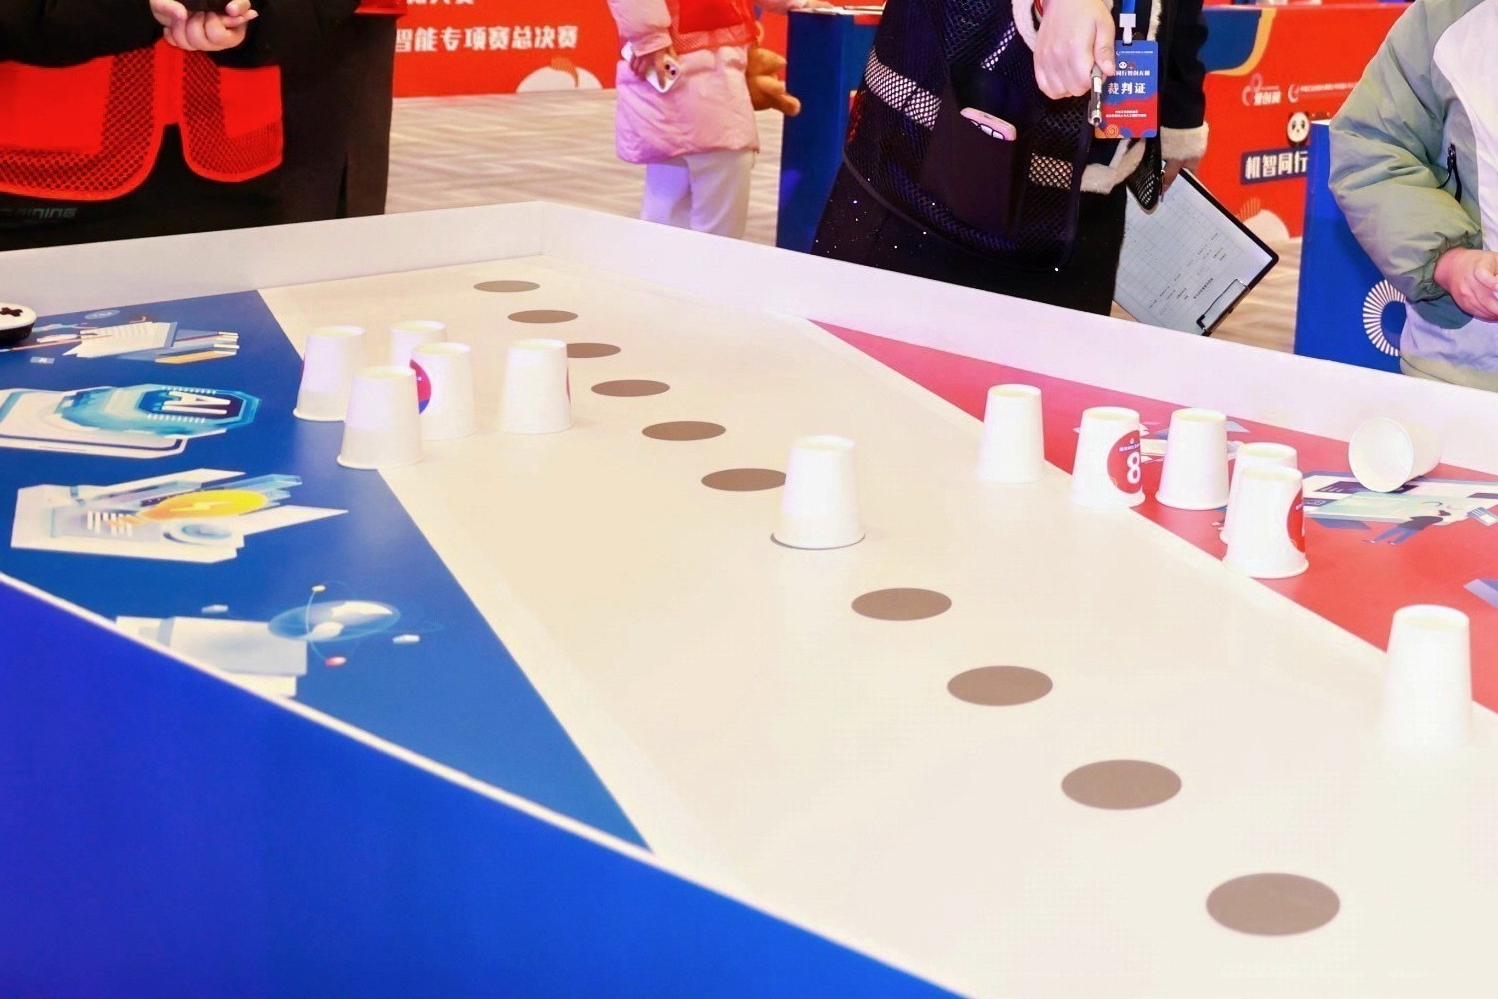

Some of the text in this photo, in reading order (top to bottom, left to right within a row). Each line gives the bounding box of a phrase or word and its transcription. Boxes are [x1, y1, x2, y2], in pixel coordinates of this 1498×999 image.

[1108, 82, 1146, 95] 裁判证
[1245, 150, 1309, 180] 机智同行
[1126, 451, 1141, 484] 8
